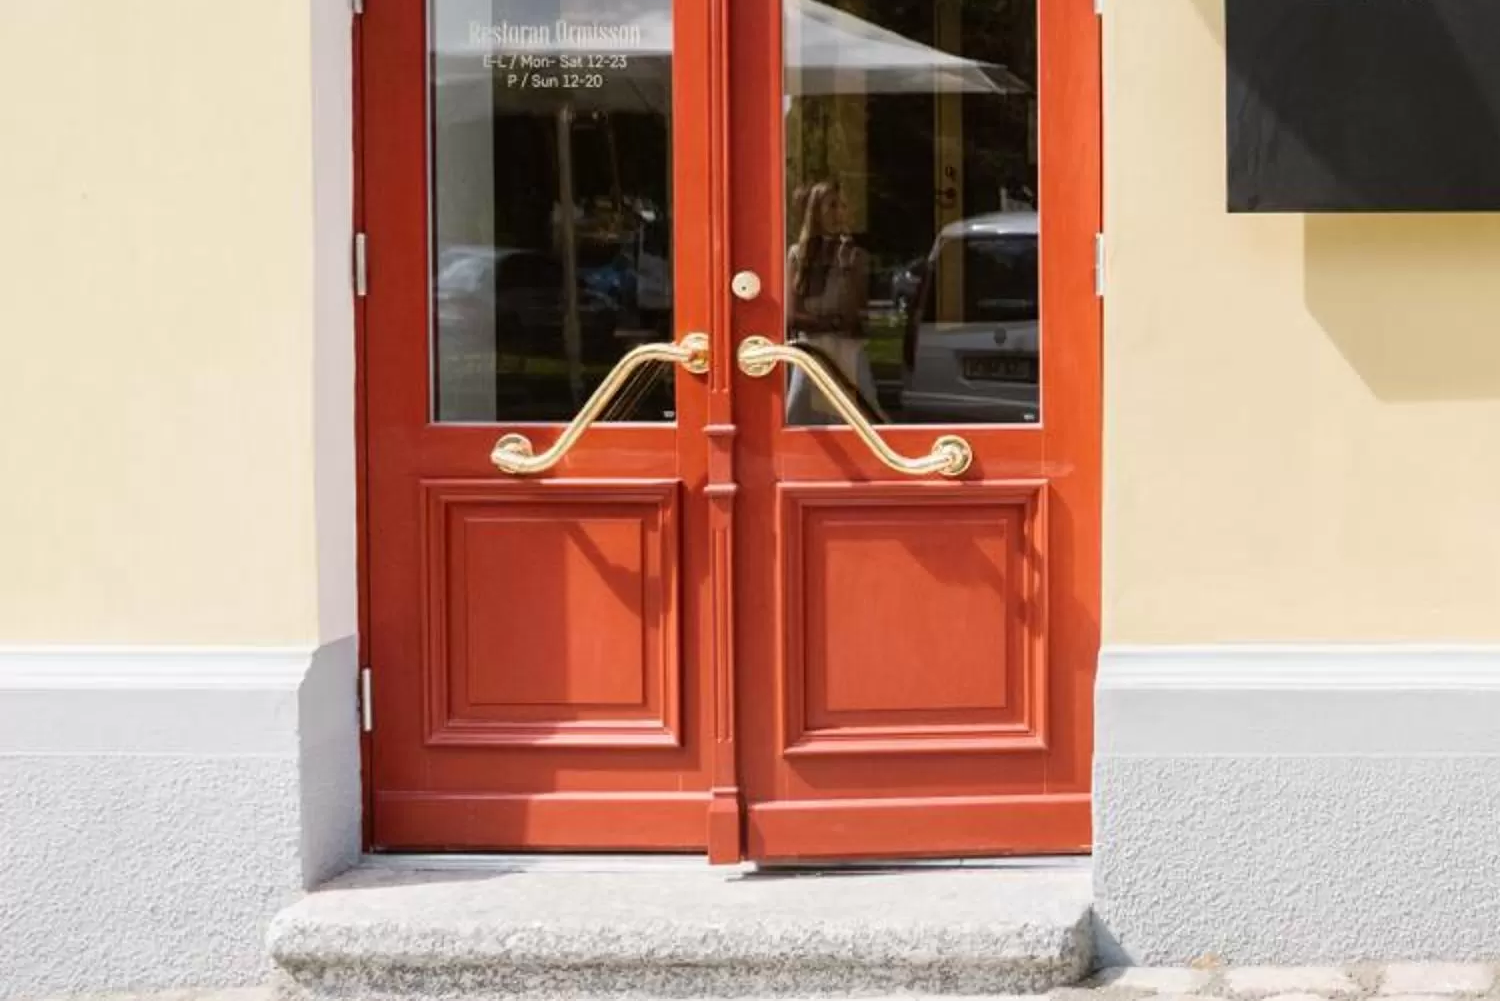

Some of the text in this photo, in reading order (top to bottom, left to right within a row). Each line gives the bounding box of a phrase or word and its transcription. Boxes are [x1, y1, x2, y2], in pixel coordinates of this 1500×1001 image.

[559, 55, 583, 68] Sat
[587, 55, 628, 69] 12-23
[507, 75, 518, 88] P
[531, 74, 559, 88] Sun
[562, 74, 604, 88] 12-20
